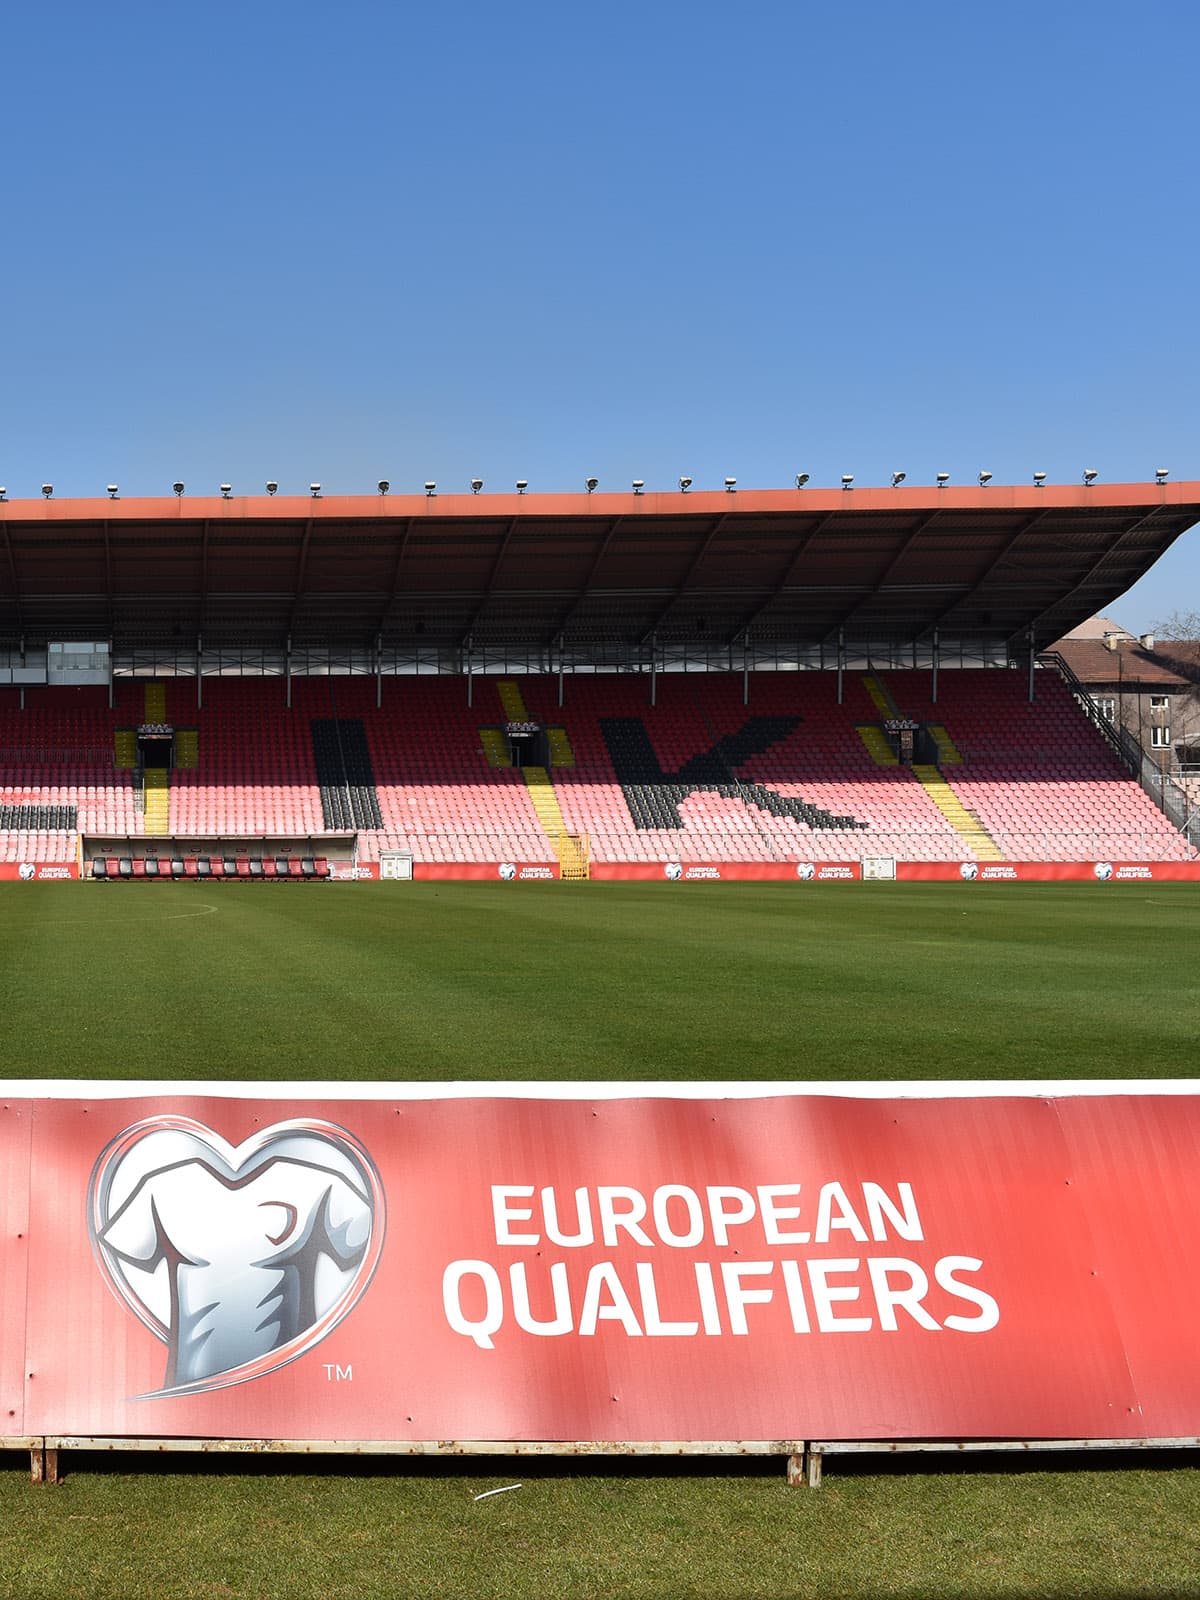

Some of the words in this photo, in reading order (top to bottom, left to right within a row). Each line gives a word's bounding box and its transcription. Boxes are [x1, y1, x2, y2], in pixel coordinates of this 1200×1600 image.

[490, 1180, 925, 1249] EUROPEAN
[441, 1254, 1002, 1350] QUALIFIERS
[323, 1364, 354, 1382] TM
